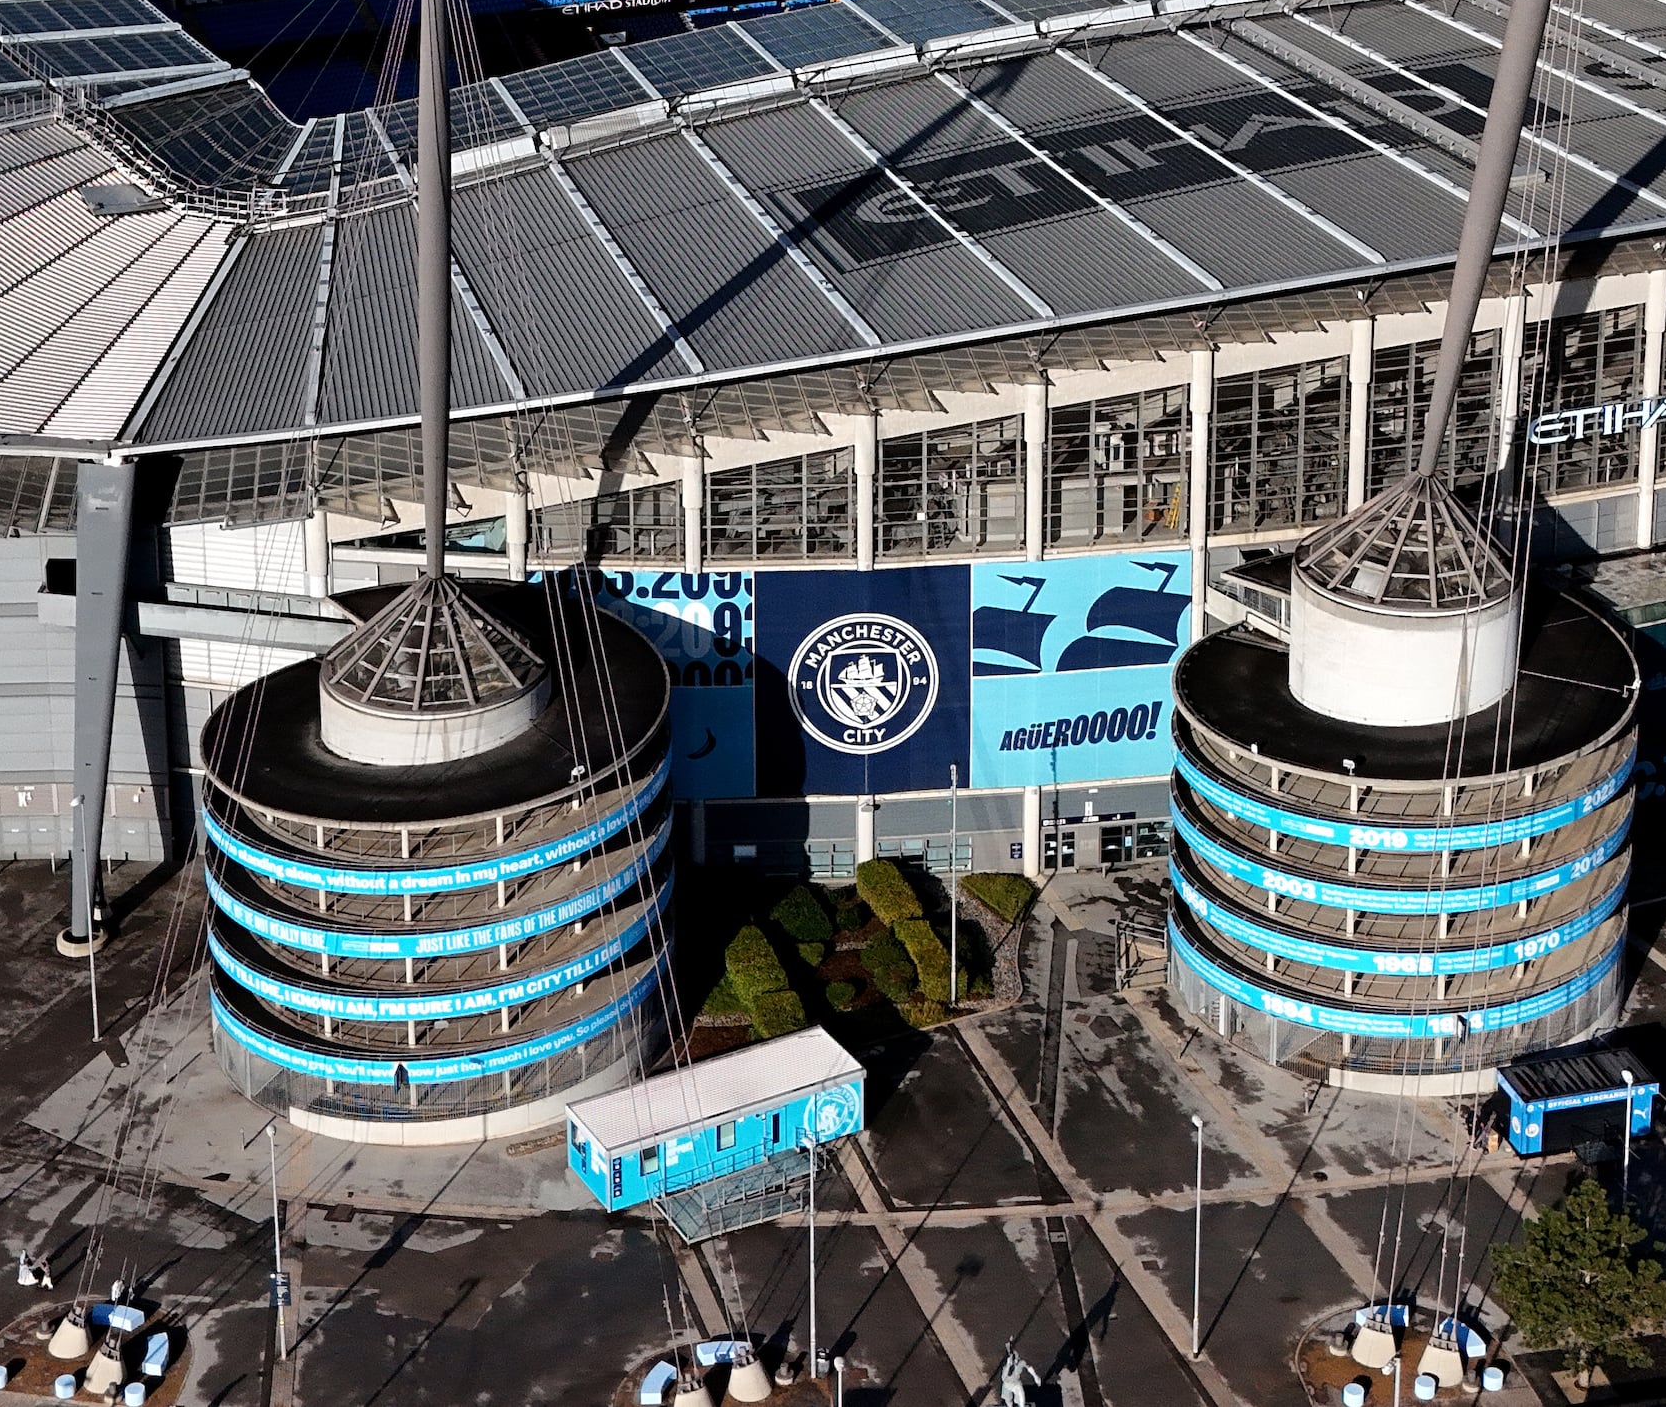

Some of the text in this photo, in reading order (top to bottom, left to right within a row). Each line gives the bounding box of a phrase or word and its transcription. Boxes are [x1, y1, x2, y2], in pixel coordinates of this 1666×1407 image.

[805, 624, 923, 671] MANCHESTER
[801, 680, 813, 692] 18
[912, 675, 927, 686] 94
[841, 727, 886, 744] CITY
[999, 700, 1163, 751] AGÜEROOOO!
[1583, 777, 1615, 812] 2022
[1349, 827, 1408, 849] 2019
[238, 846, 285, 878] standing
[285, 867, 326, 886] alone,
[326, 874, 387, 891] without
[388, 878, 399, 889] a
[401, 874, 454, 889] dream
[455, 870, 472, 884] in
[473, 865, 498, 881] my
[500, 854, 544, 875] heart,
[545, 828, 598, 862] without
[1570, 847, 1605, 880] 2012
[1262, 870, 1317, 901] 2003
[416, 936, 445, 954] JUST
[446, 932, 472, 951] LIKE
[472, 928, 494, 947] THE
[494, 921, 522, 942] FANS
[524, 917, 537, 934] OF
[537, 909, 557, 930] THE
[558, 886, 602, 919] INVISIBLE
[1513, 931, 1561, 960] 1970
[1373, 955, 1433, 974] 1968
[291, 991, 337, 1012] KNOW
[338, 1000, 344, 1013] I
[345, 1001, 378, 1018] AM,
[379, 1000, 406, 1016] I'M
[408, 998, 453, 1015] SURE
[456, 996, 462, 1011] I
[463, 992, 498, 1009] AM,
[499, 987, 525, 1004] I'M
[526, 972, 564, 995] CITY
[563, 960, 594, 982] TILL
[594, 955, 600, 966] I
[336, 1063, 365, 1076] You'll
[367, 1065, 400, 1078] neve
[406, 1064, 433, 1077] now
[435, 1062, 459, 1079] just
[461, 1058, 485, 1074] how
[488, 1049, 522, 1069] much
[523, 1047, 528, 1058] I
[529, 1040, 553, 1056] love
[554, 1033, 576, 1051] you.
[576, 1023, 590, 1038] So
[590, 1008, 619, 1031] please
[1548, 1090, 1636, 1109] OFFICIAL MERCHANDIE
